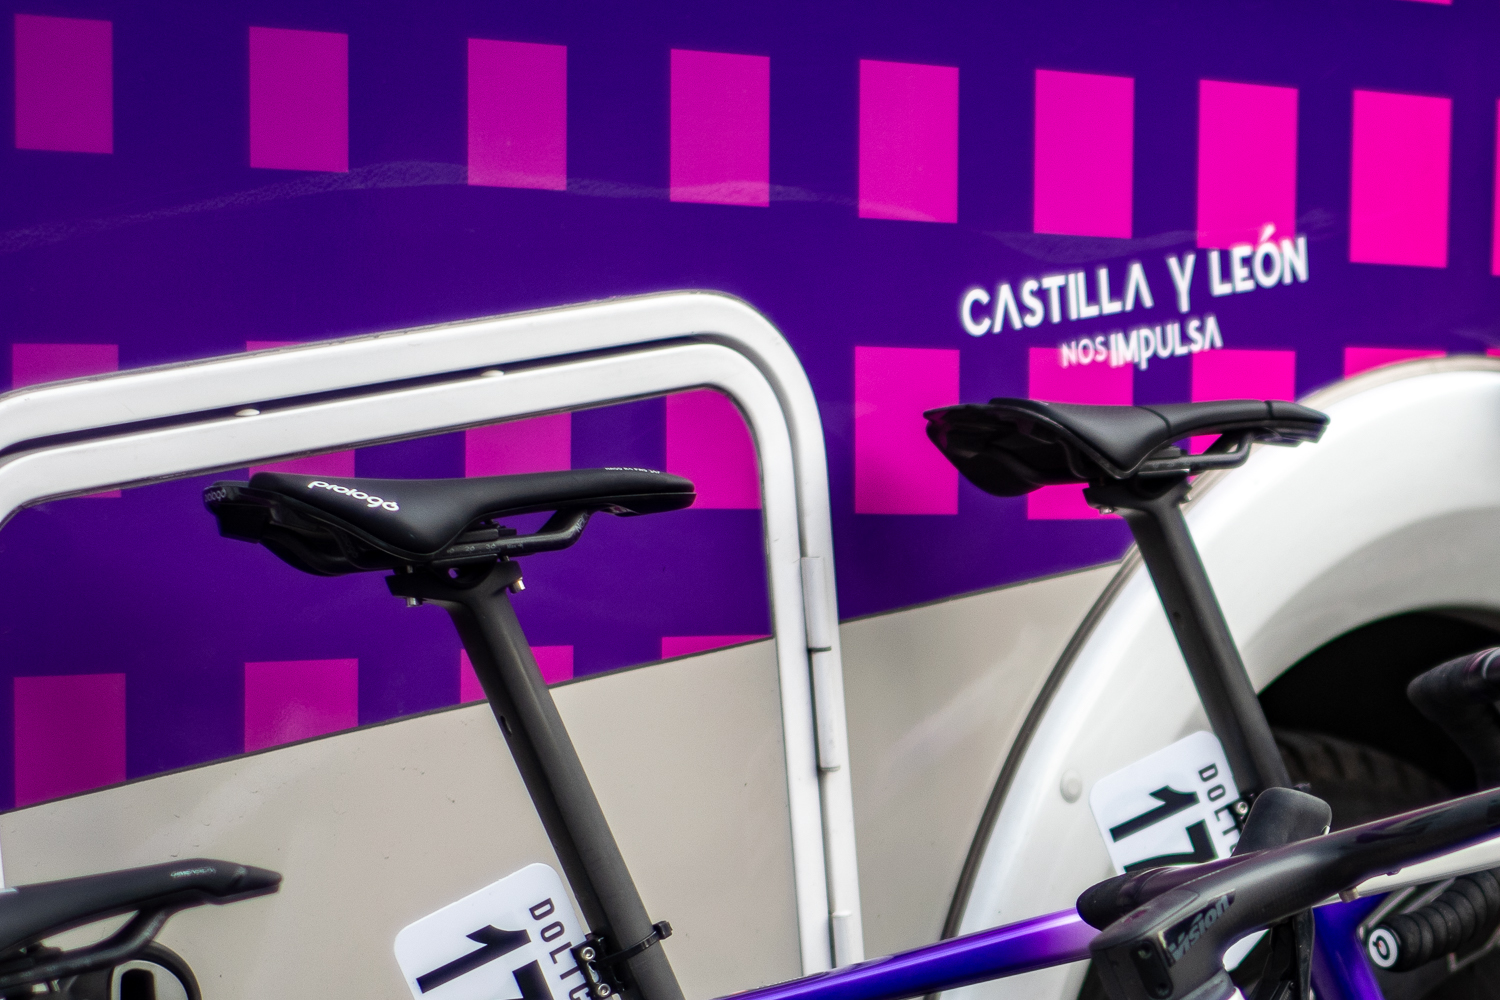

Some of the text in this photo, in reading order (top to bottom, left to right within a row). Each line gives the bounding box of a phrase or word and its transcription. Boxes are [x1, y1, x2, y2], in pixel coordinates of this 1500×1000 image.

[961, 224, 1309, 337] CASTILLA Y LEÓN
[307, 480, 399, 512] prologo
